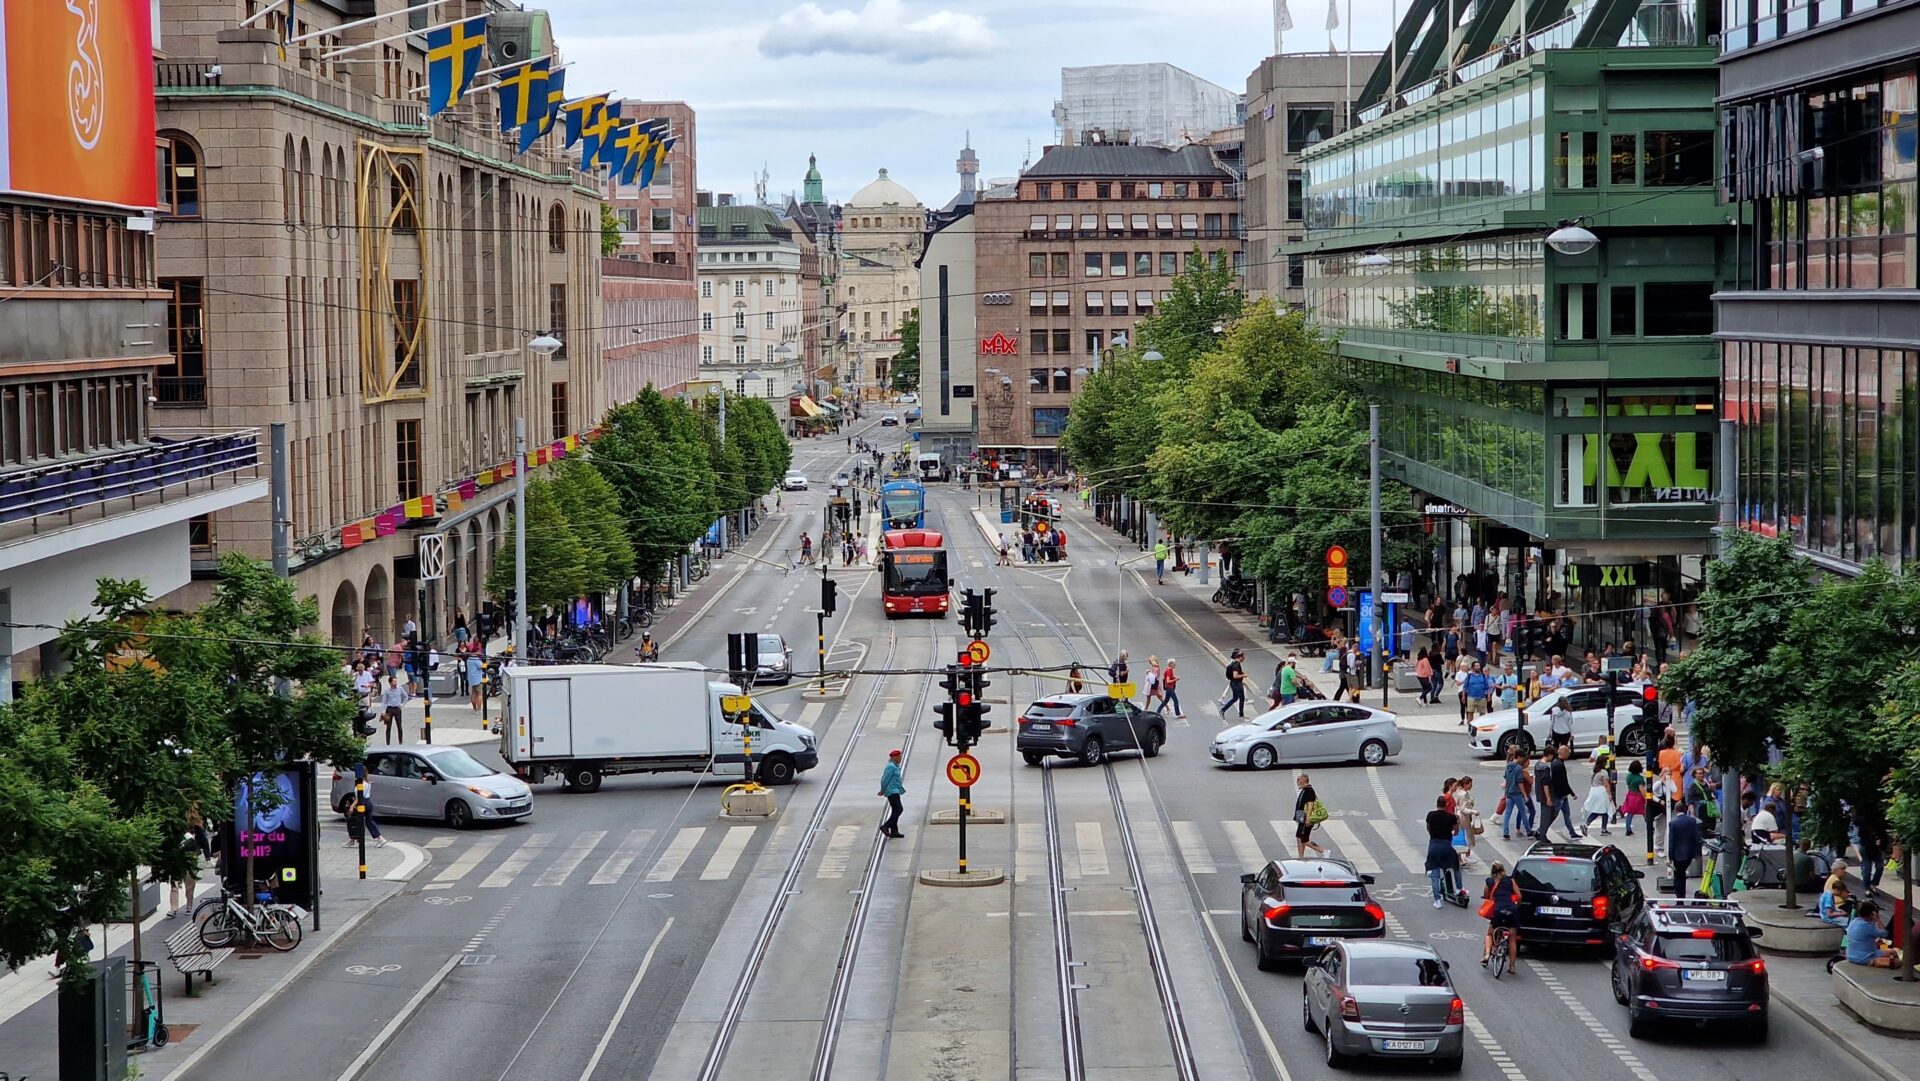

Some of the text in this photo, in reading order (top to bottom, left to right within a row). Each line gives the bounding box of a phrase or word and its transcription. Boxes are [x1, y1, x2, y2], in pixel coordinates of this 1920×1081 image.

[981, 331, 1018, 355] MAX
[1583, 404, 1709, 488] XXL
[1600, 566, 1636, 586] XXL
[267, 830, 286, 841] du
[1397, 1041, 1412, 1049] 0127
